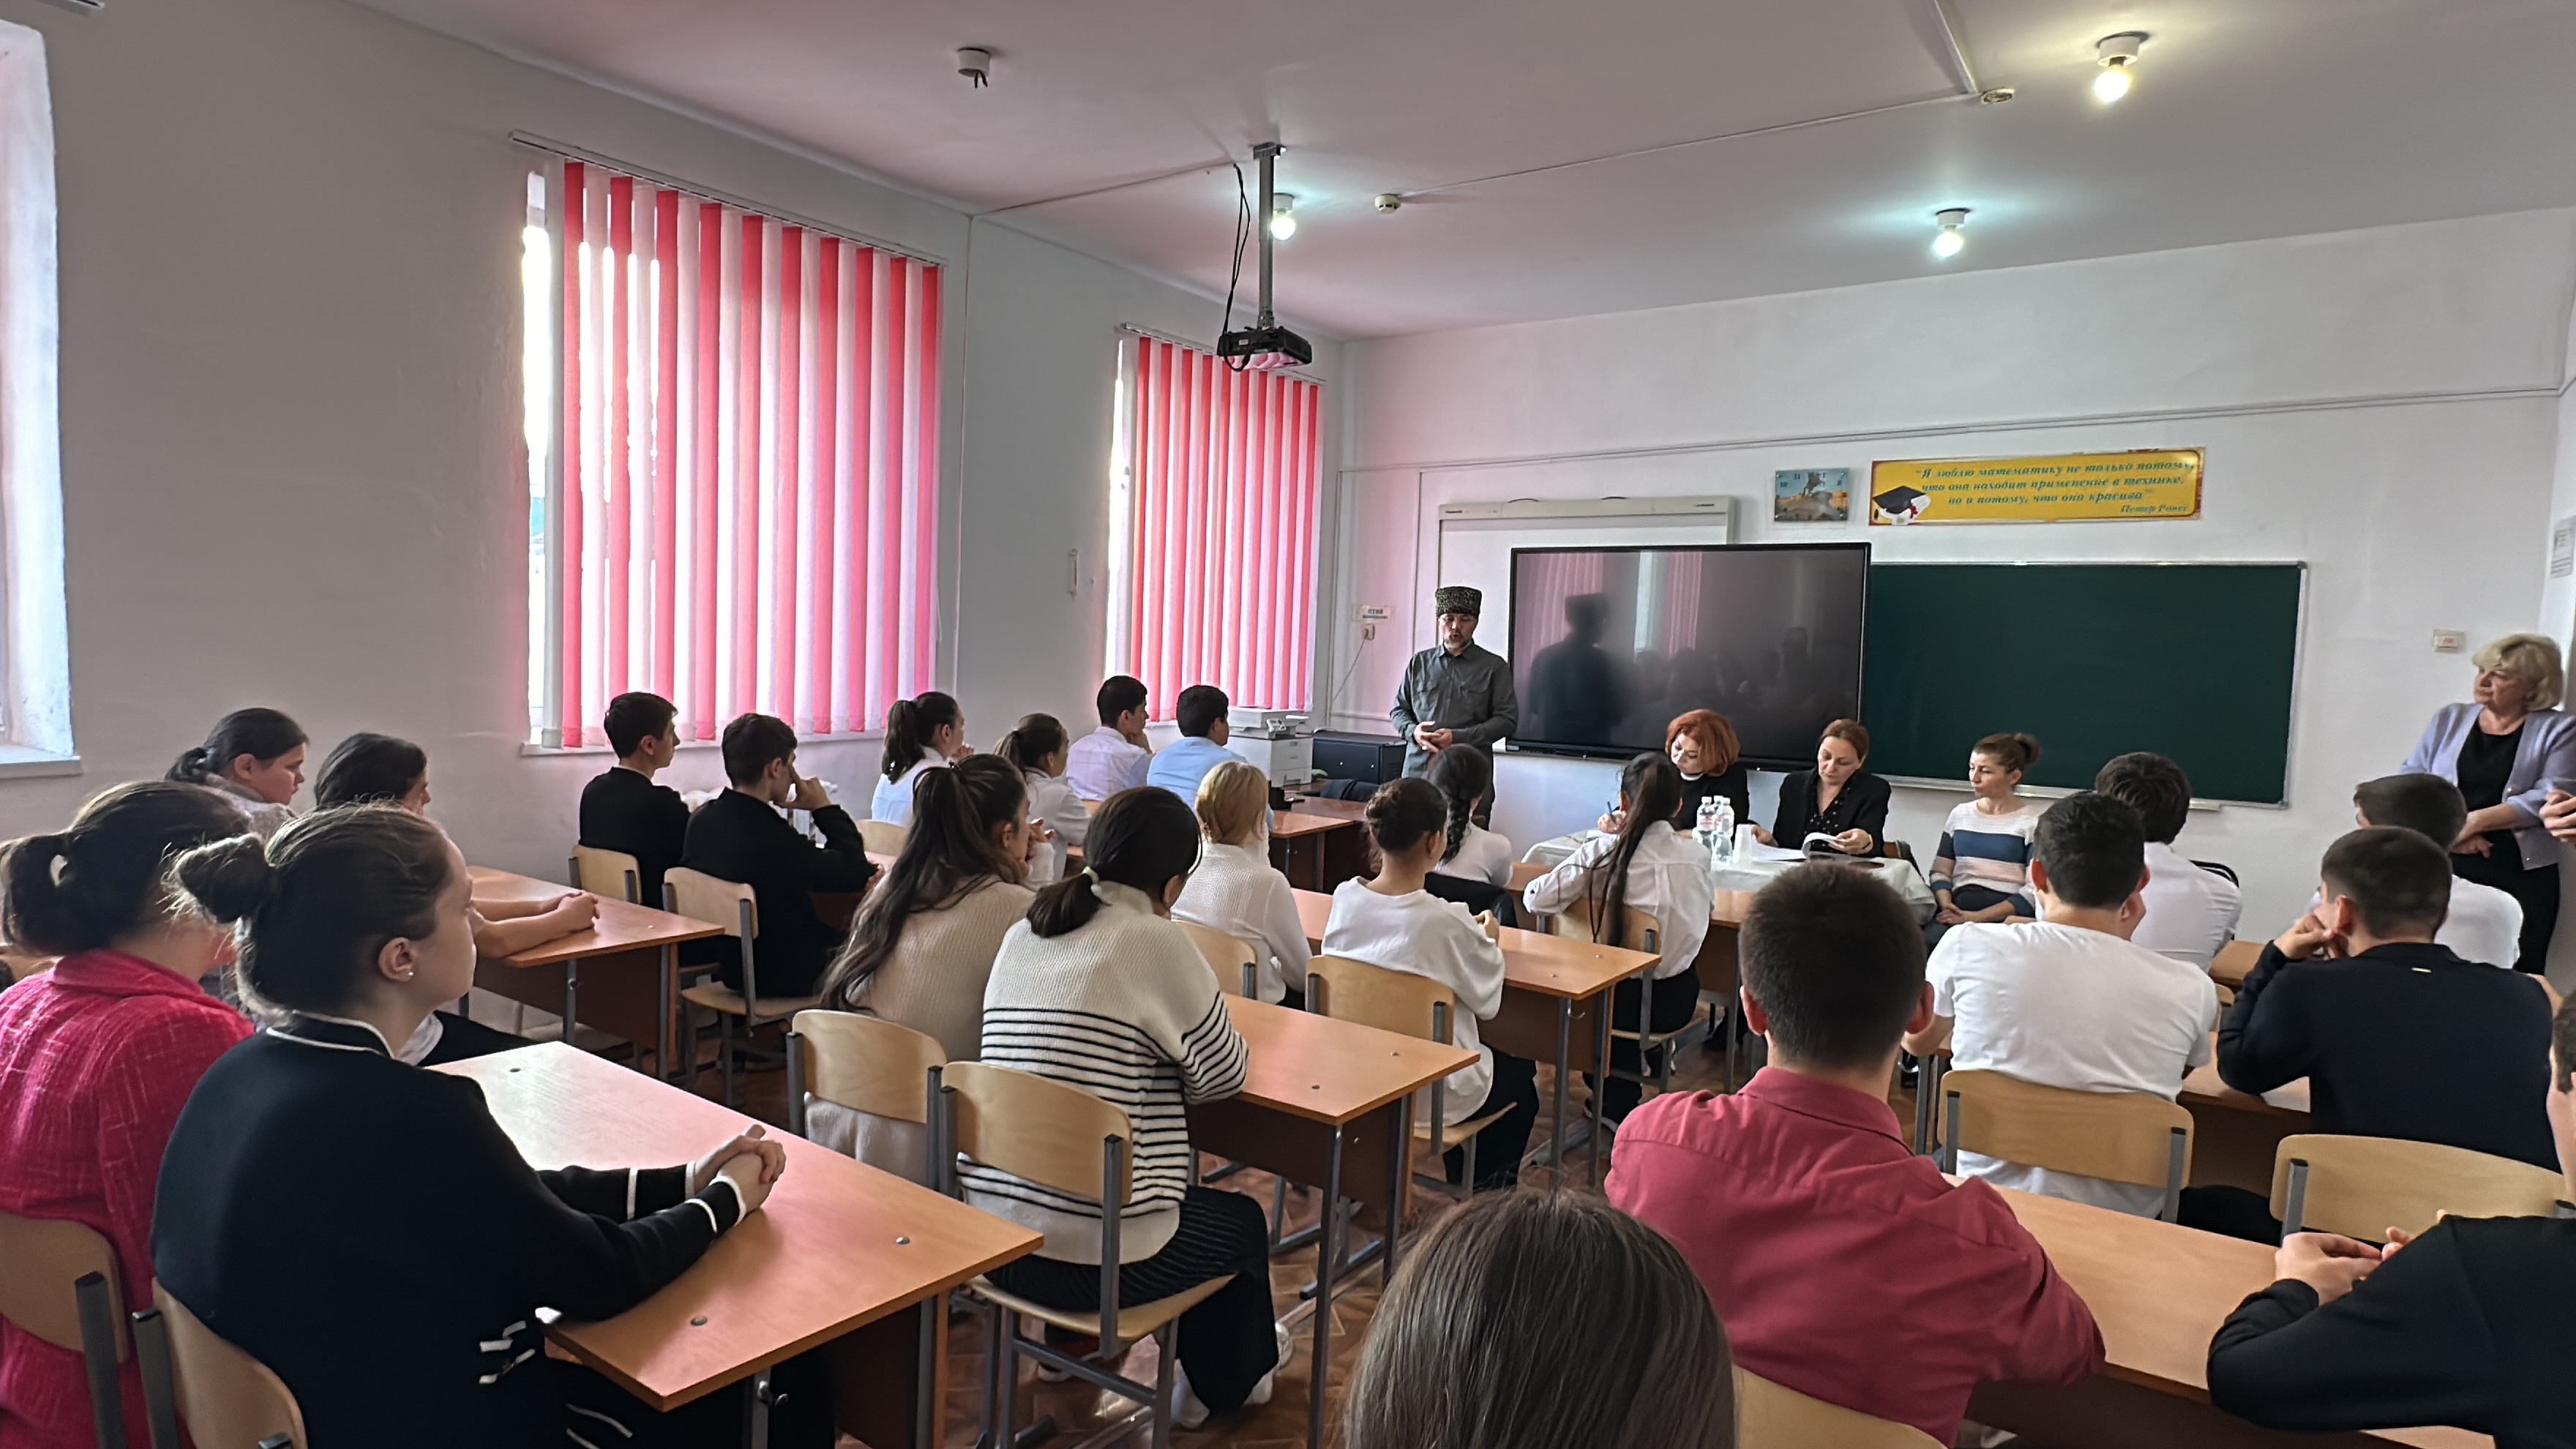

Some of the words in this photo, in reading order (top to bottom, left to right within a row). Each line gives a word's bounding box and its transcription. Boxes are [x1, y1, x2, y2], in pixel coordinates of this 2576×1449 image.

[1936, 468, 1974, 477] люблю
[1979, 466, 2063, 476] математику
[2067, 465, 2081, 473] не
[2085, 463, 2134, 473] только
[1974, 481, 2027, 490] находит
[2031, 479, 2108, 491] применение
[1977, 495, 2027, 505] потому,
[2033, 495, 2058, 503] что
[2061, 494, 2084, 502] она
[2121, 505, 2156, 514] Петер
